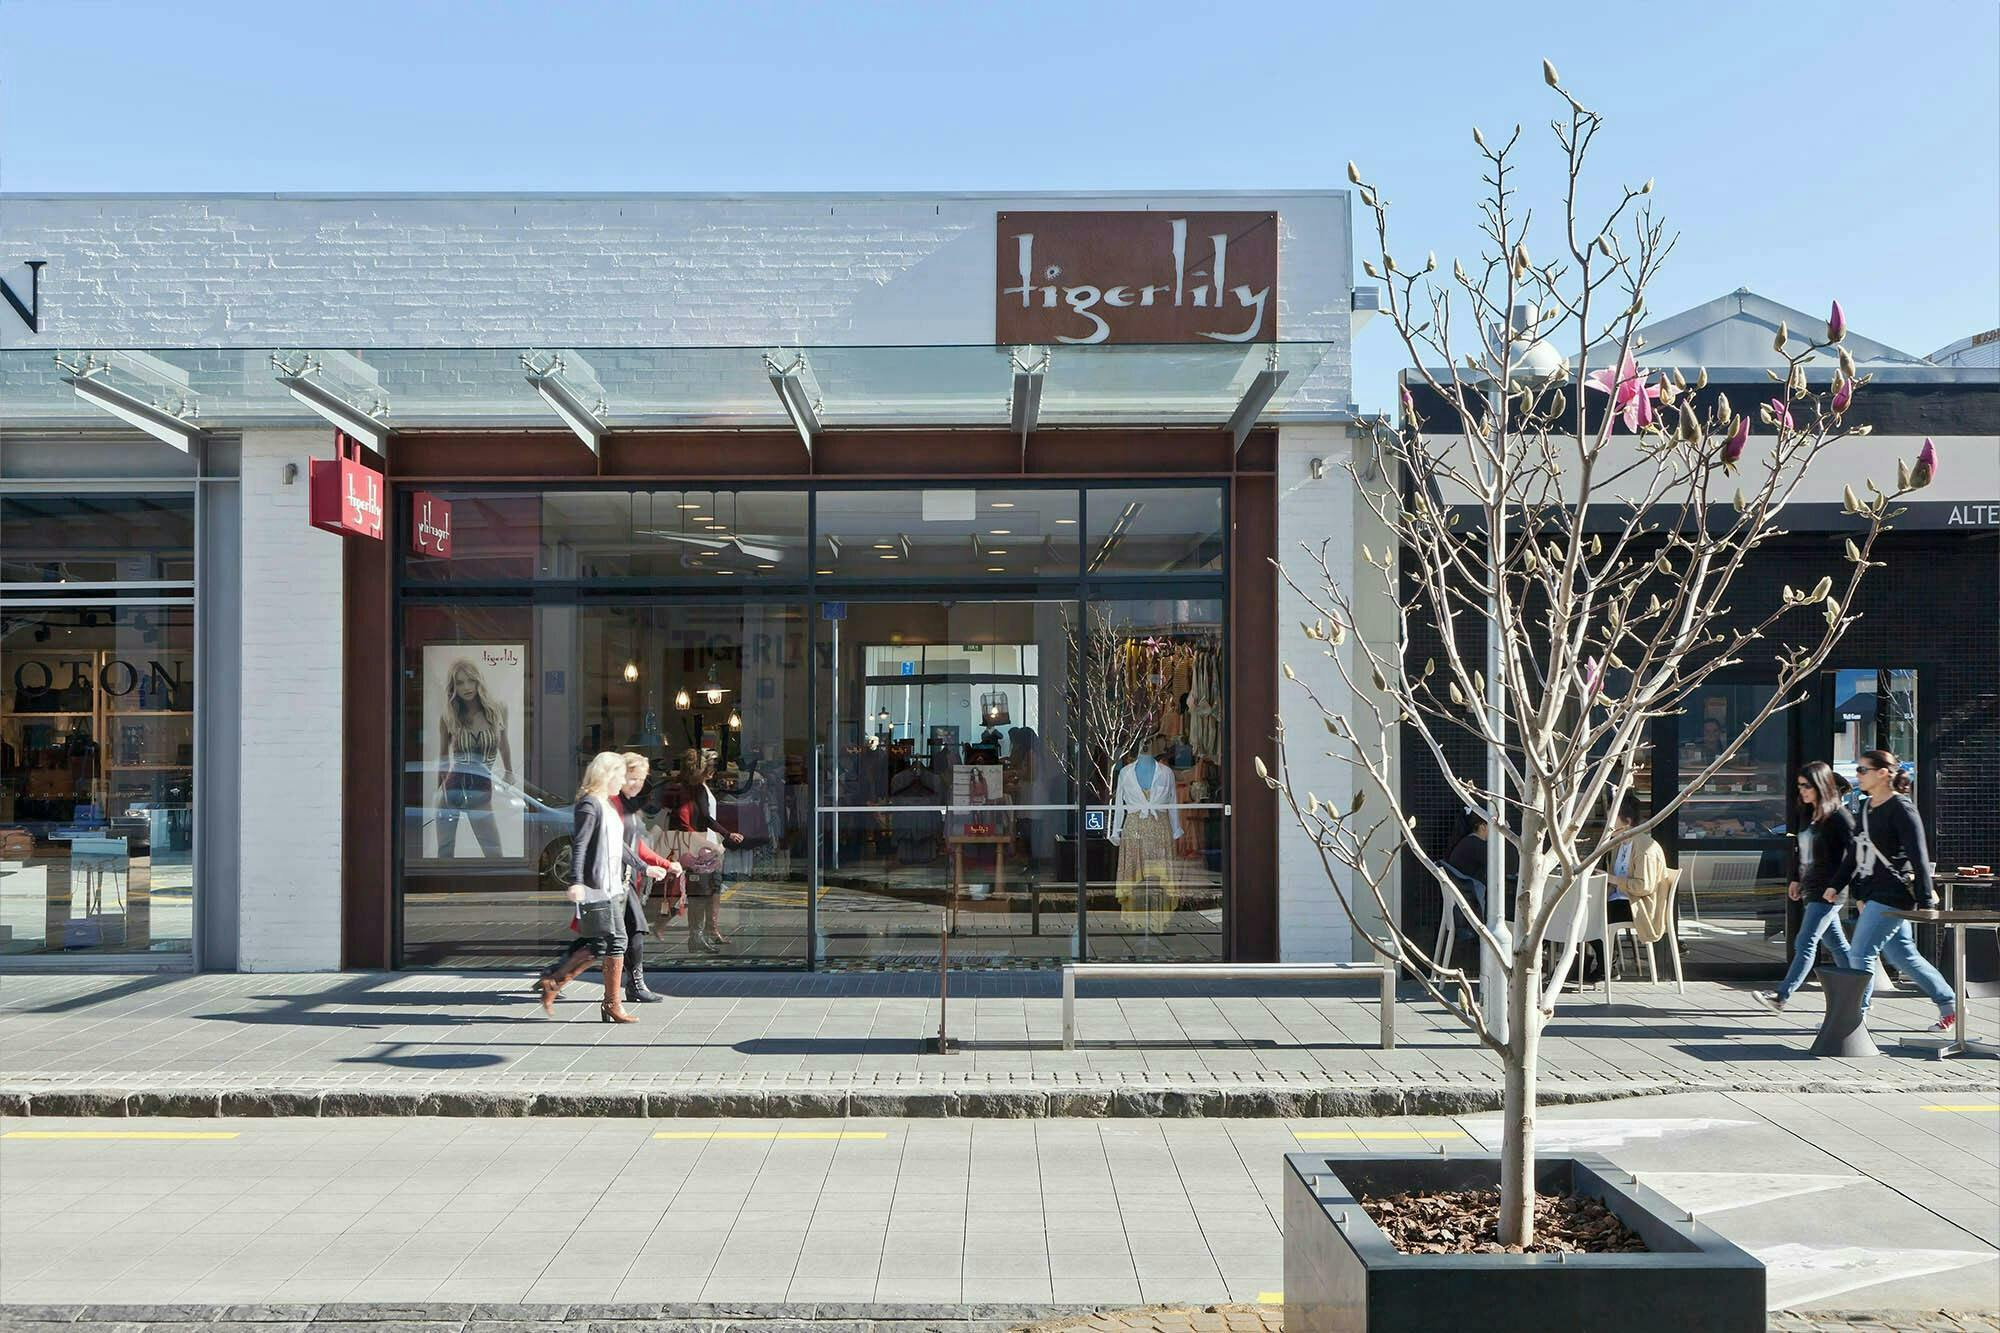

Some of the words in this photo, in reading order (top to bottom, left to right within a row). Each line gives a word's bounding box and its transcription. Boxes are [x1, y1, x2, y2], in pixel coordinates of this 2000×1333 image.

[1003, 218, 1271, 345] tigerlily
[346, 472, 383, 530] tigerlily
[1948, 505, 2000, 525] ALTE
[14, 660, 184, 697] OTON
